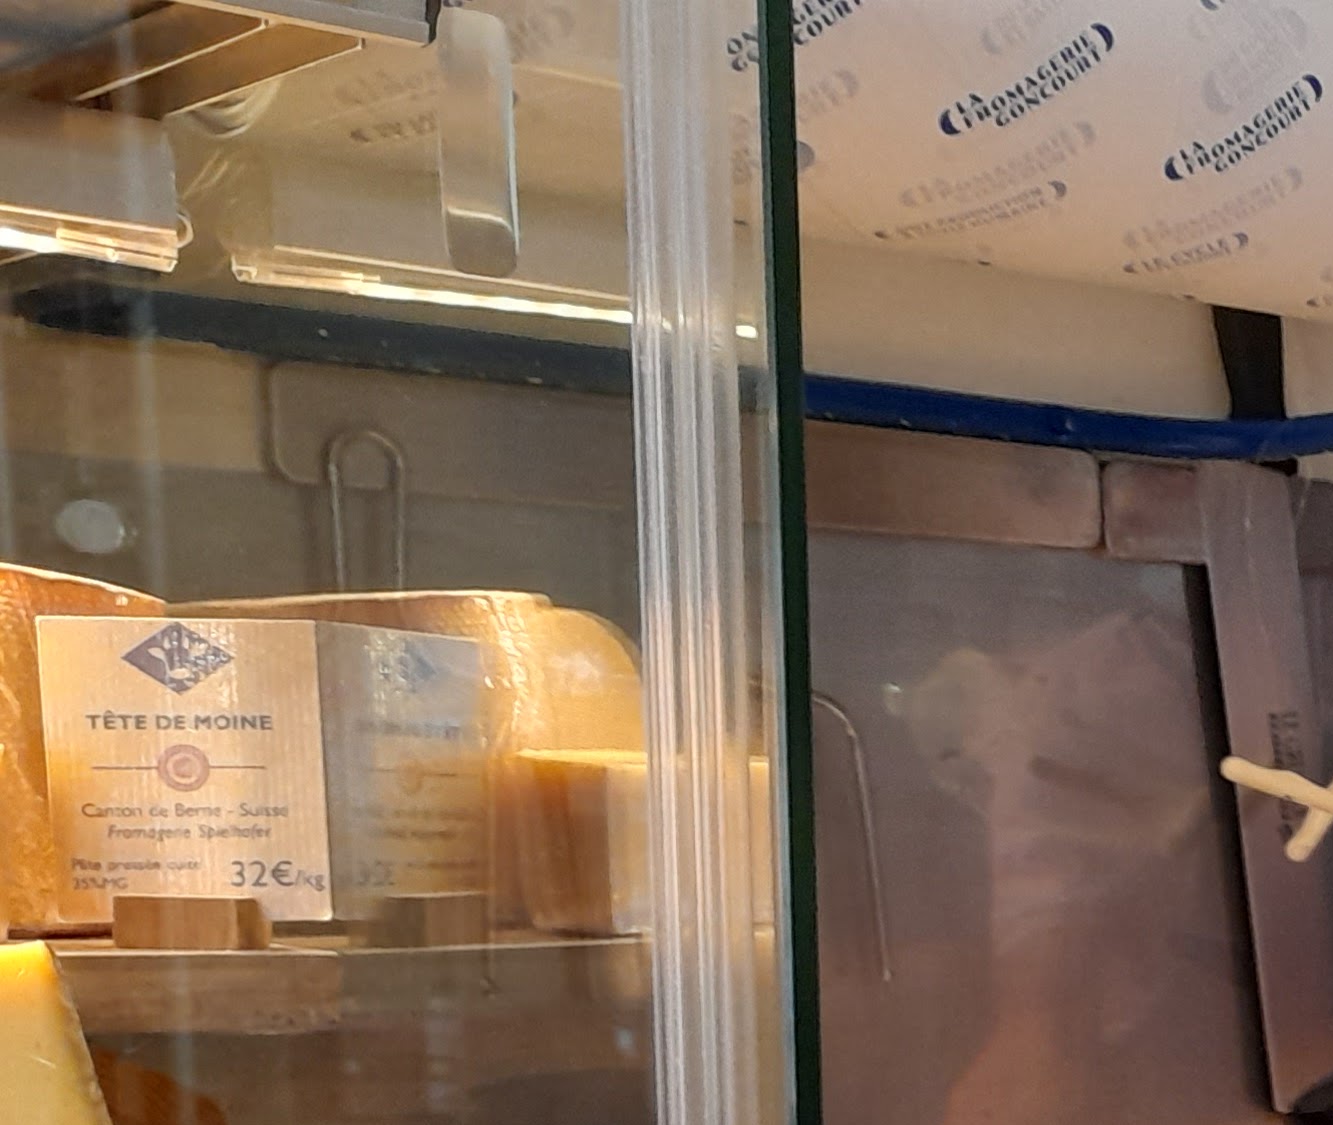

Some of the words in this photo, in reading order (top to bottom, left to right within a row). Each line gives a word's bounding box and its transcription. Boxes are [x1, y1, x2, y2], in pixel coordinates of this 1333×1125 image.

[963, 31, 1096, 129] FROMAGERIE
[995, 43, 1101, 127] GONCOURT
[956, 93, 984, 114] LA
[1186, 81, 1305, 175] FROMAGERIE
[1215, 98, 1311, 172] GONCOURT
[1179, 141, 1205, 160] LA
[85, 710, 148, 731] TÊTE
[155, 714, 187, 731] DE
[194, 713, 274, 731] MOINE
[81, 803, 143, 818] Canton
[150, 803, 169, 818] de
[239, 802, 289, 818] Suisse
[107, 824, 191, 842] Fromagerie
